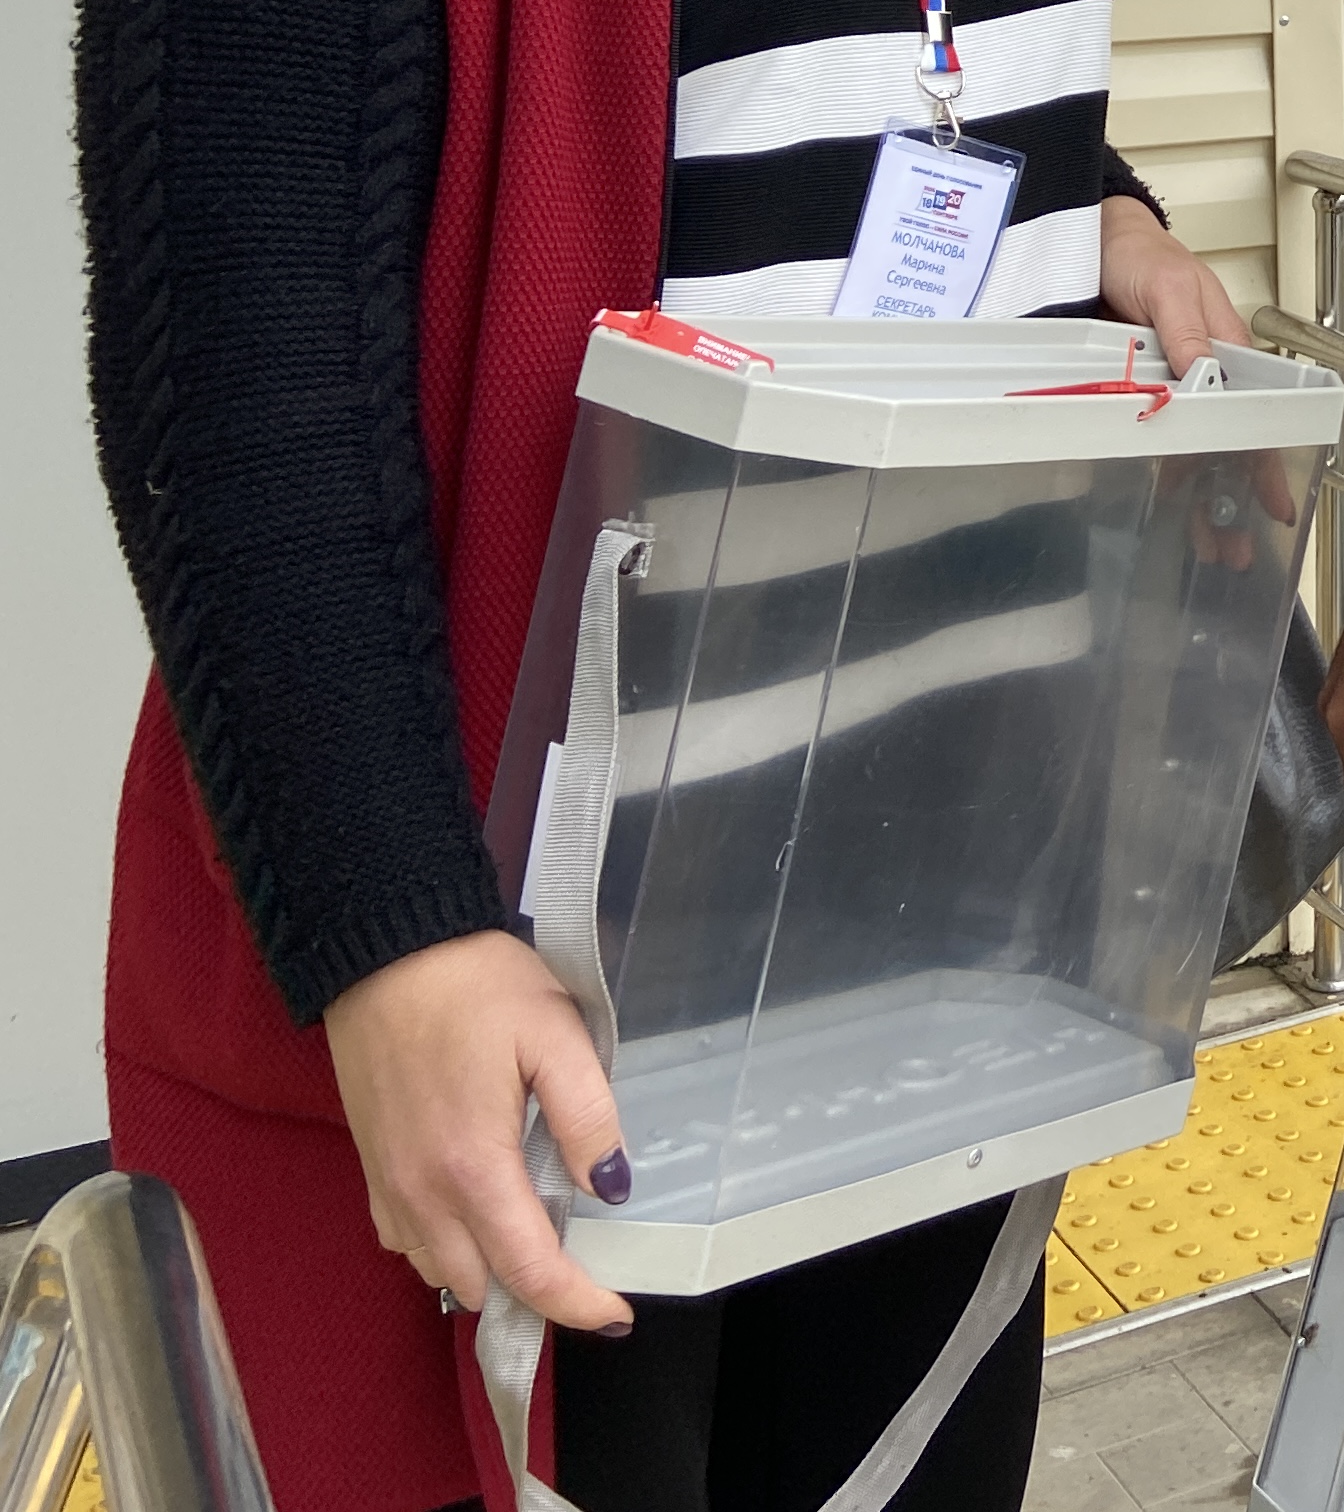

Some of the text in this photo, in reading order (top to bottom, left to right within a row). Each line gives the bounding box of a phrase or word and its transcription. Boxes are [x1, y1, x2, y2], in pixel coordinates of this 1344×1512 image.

[891, 230, 965, 261] МОЛЧАНОВА
[901, 252, 946, 275] Марина
[886, 269, 947, 296] Сергеевна
[876, 294, 936, 318] СЕКРЕТАРЬ
